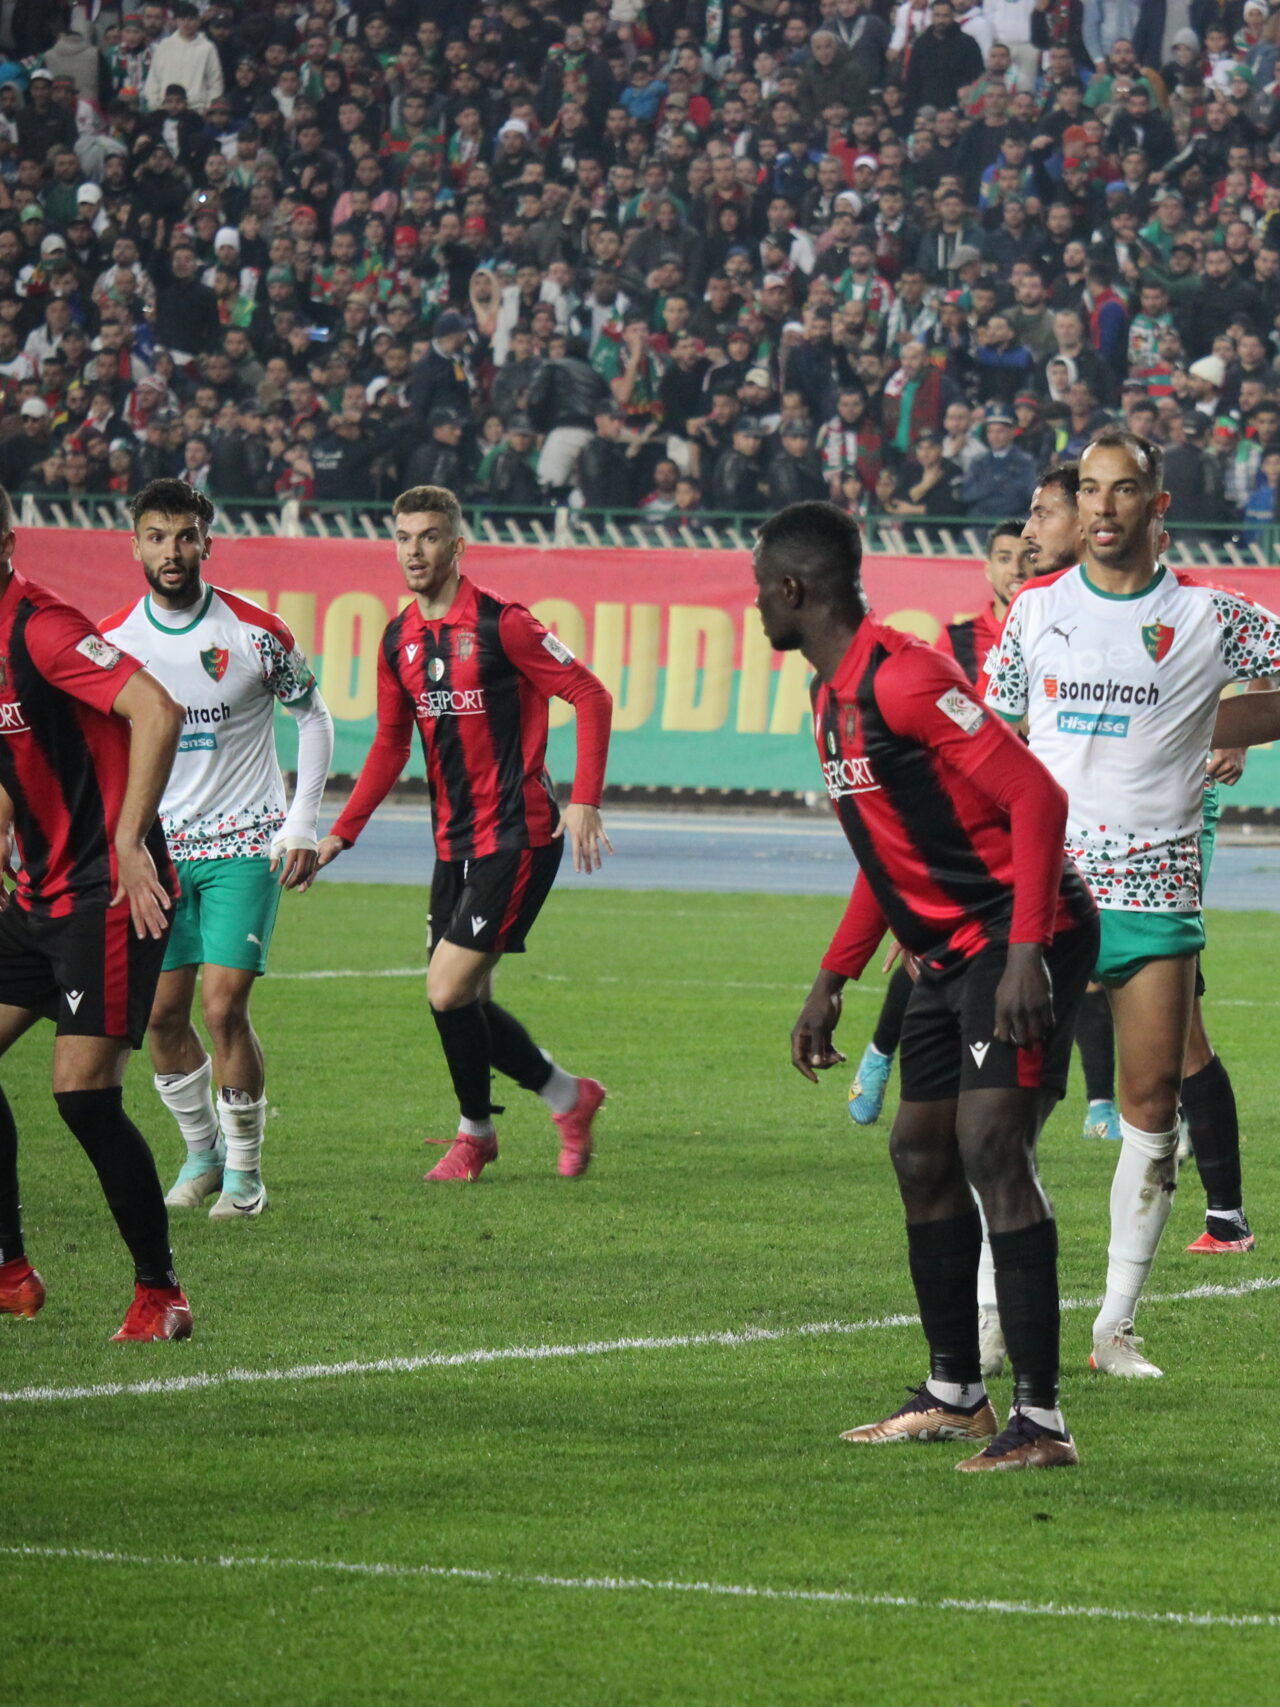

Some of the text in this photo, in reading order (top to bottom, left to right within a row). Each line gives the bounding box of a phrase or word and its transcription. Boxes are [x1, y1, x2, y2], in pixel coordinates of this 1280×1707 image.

[1060, 679, 1159, 705] sonatrach
[184, 702, 230, 724] trach
[180, 737, 214, 749] ense
